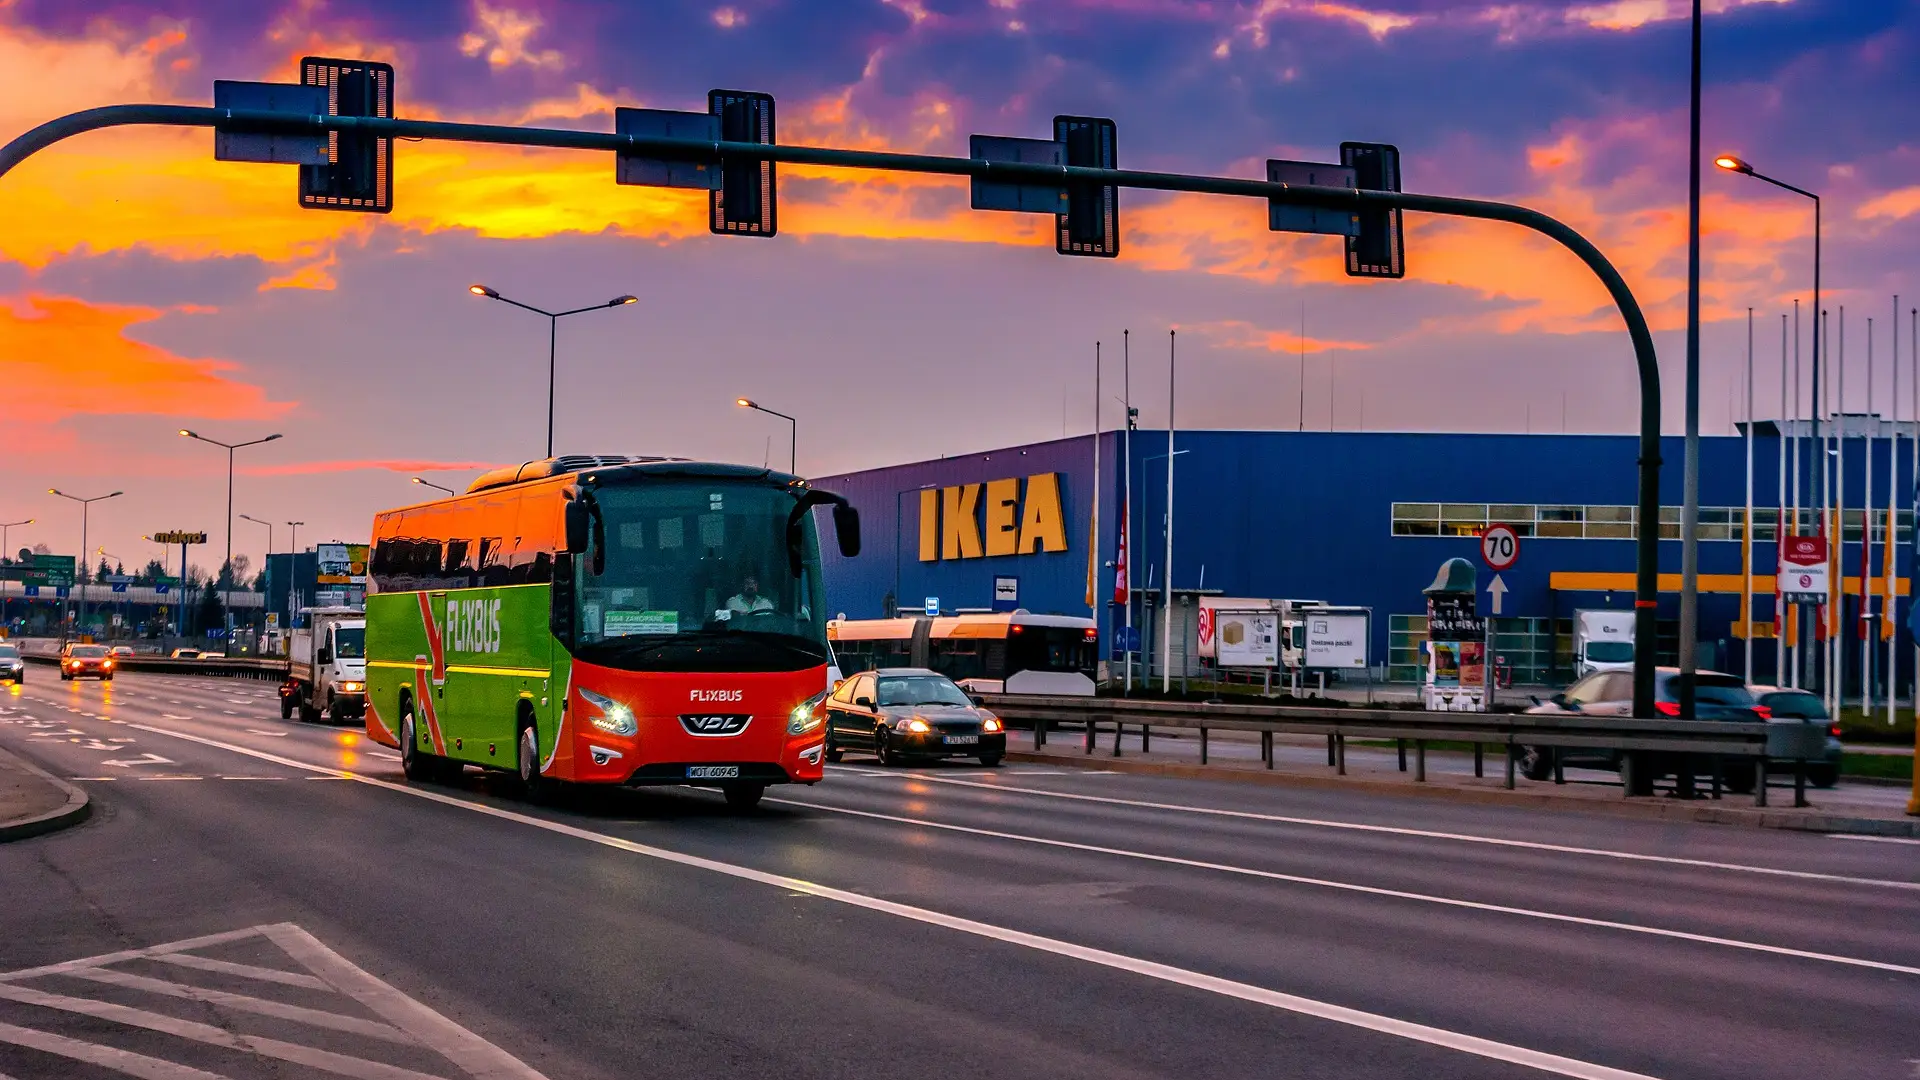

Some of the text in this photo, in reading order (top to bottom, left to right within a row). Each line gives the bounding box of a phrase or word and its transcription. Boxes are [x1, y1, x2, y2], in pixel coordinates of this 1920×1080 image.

[919, 472, 1068, 562] IKEA
[154, 530, 202, 544] makro
[1487, 536, 1513, 558] 70
[689, 716, 739, 730] VDL
[690, 767, 738, 777] WOT 60945
